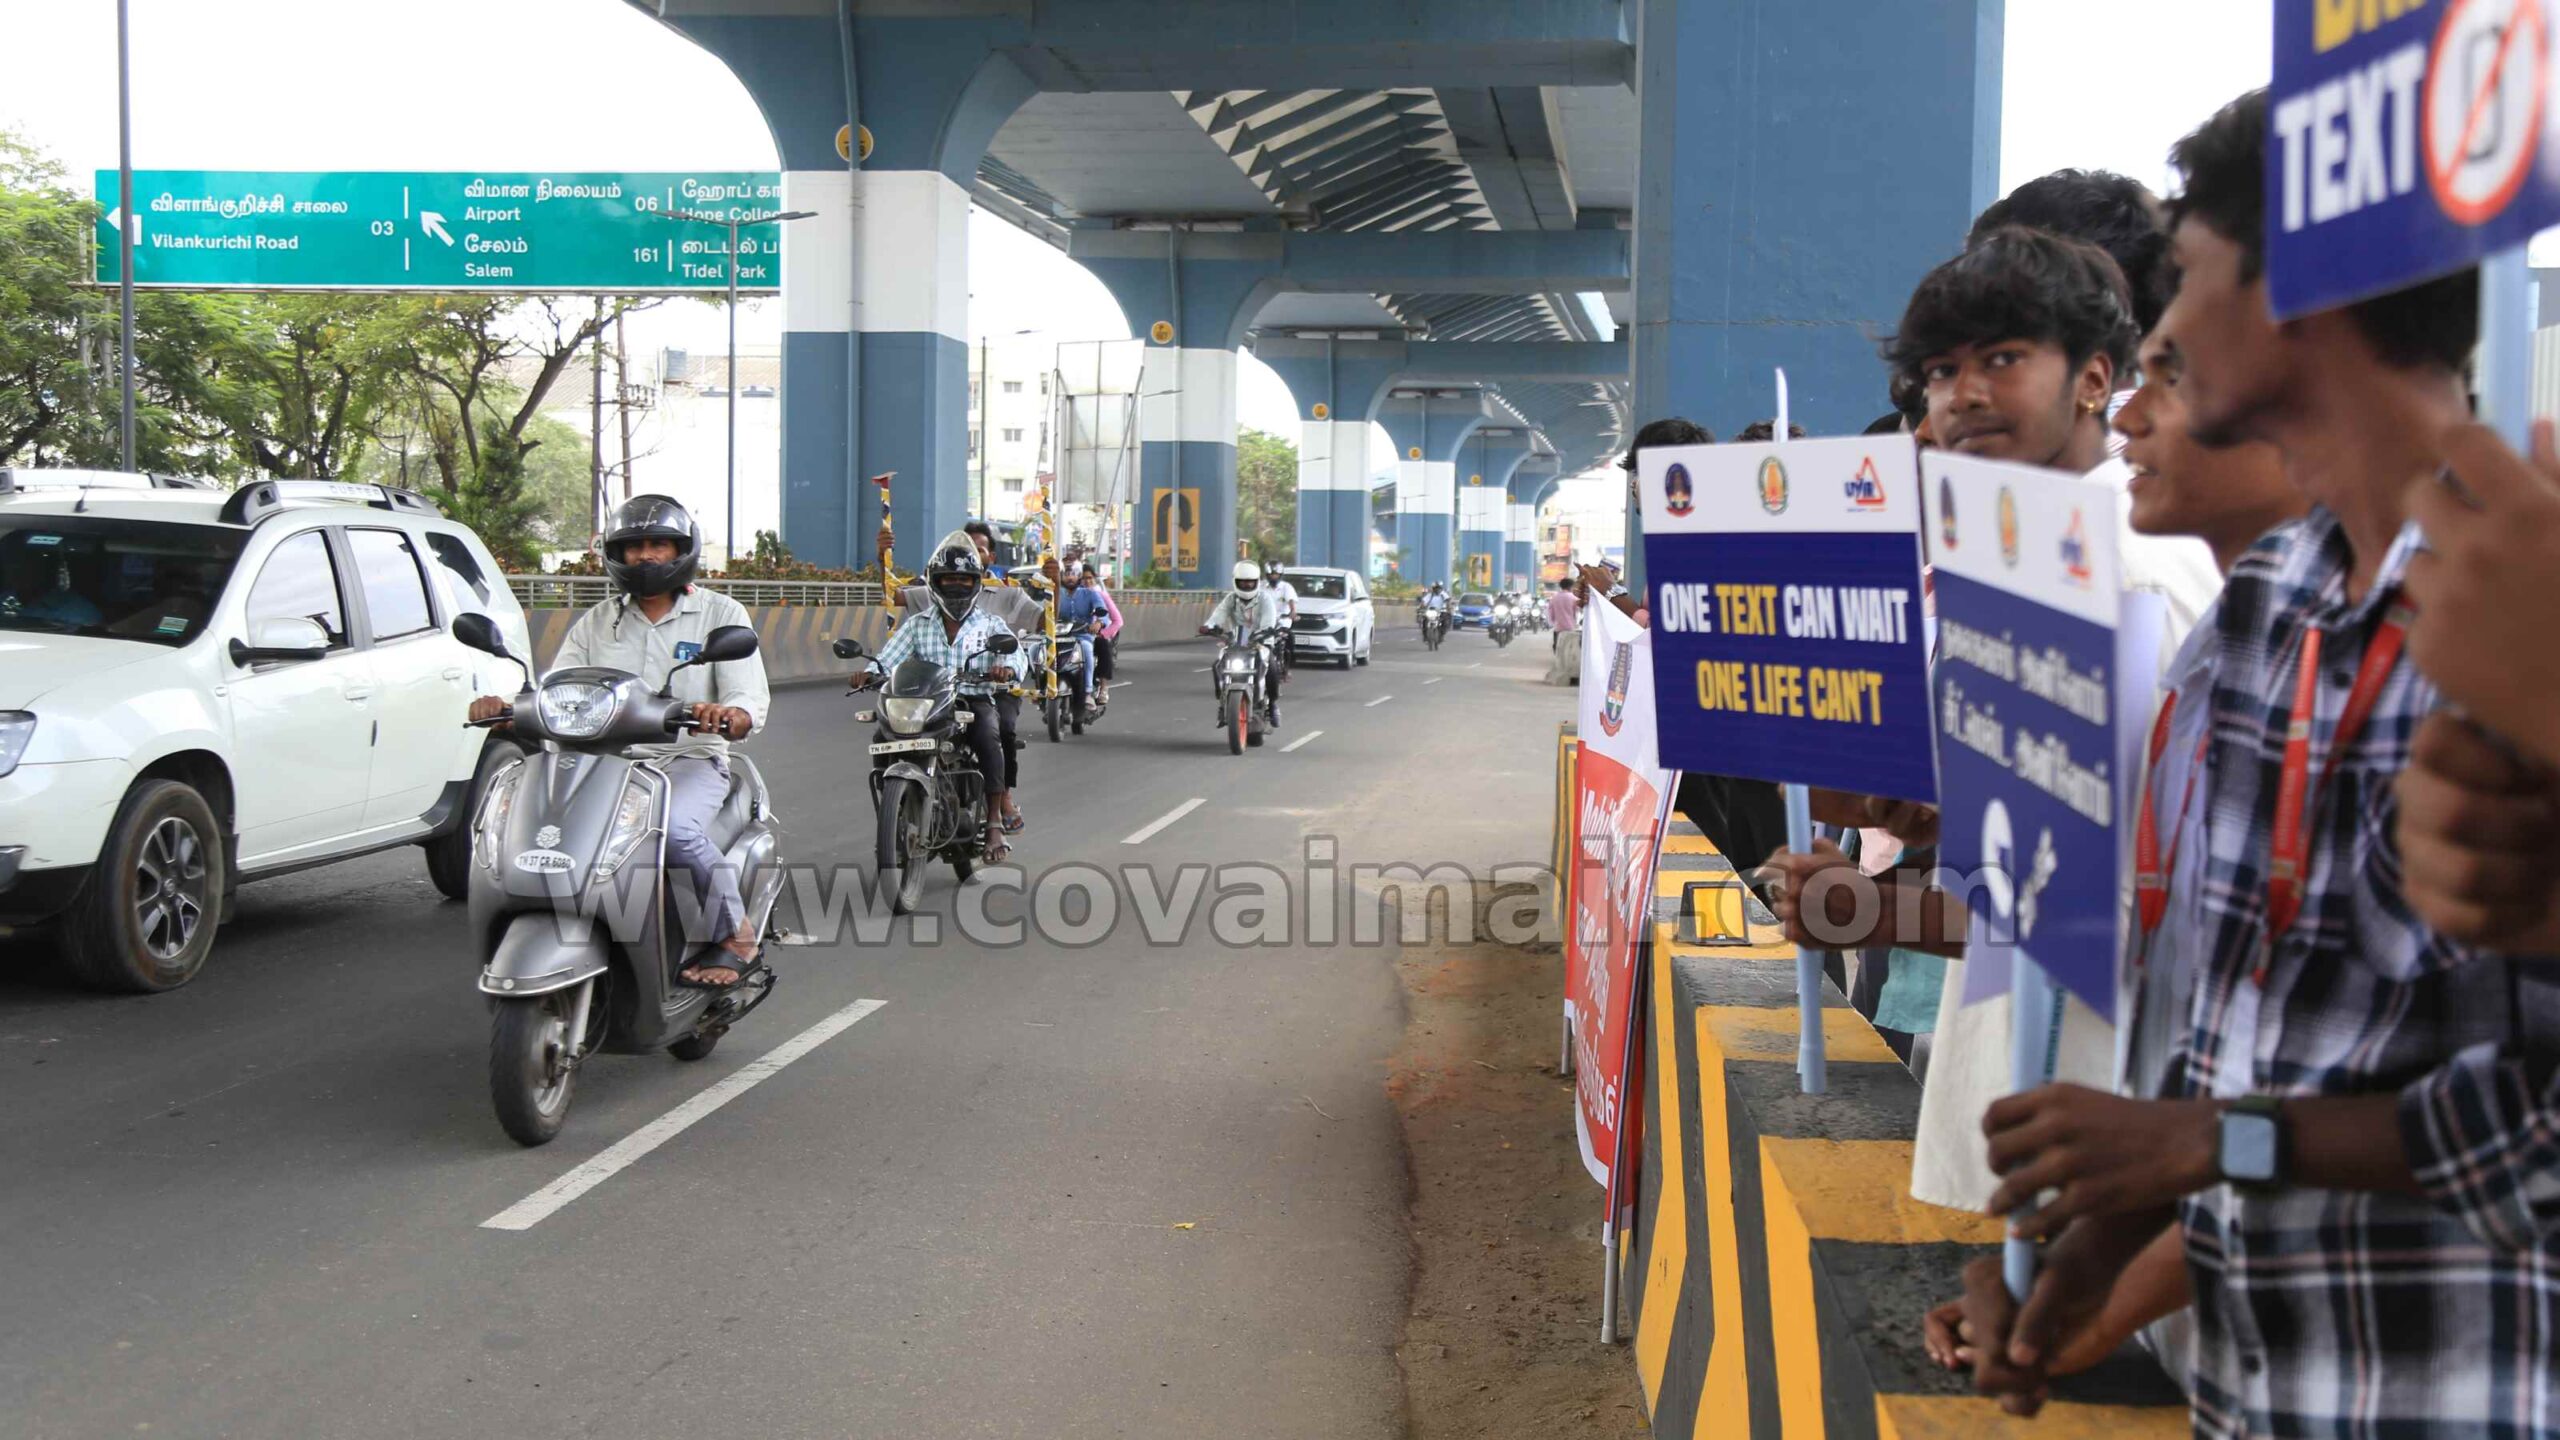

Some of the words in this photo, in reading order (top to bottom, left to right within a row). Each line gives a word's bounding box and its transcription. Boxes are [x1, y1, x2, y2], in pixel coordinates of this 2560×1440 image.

[2274, 42, 2427, 234] TEXT
[464, 178, 530, 199] விமான
[535, 178, 622, 203] நிலையம்
[681, 178, 752, 204] ஹோப்
[151, 192, 285, 219] விளாங்குறிச்சி
[292, 201, 348, 214] சாலை
[634, 196, 658, 212] 06
[464, 206, 521, 224] Airport
[729, 207, 781, 225] Colleg
[371, 221, 394, 236] 03
[151, 234, 252, 249] Vilankurichi
[255, 235, 299, 250] Road
[464, 233, 528, 254] சேலம்
[633, 248, 659, 264] 161
[464, 263, 513, 278] Salem
[681, 264, 723, 278] Tidel
[1660, 582, 1712, 633] ONE
[1714, 583, 1778, 636] TEXT
[1782, 583, 1837, 640] CAN
[1839, 586, 1909, 645] WAIT
[1696, 658, 1748, 712] ONE
[1751, 663, 1805, 718] LIFE
[1807, 666, 1883, 726] CAN'T
